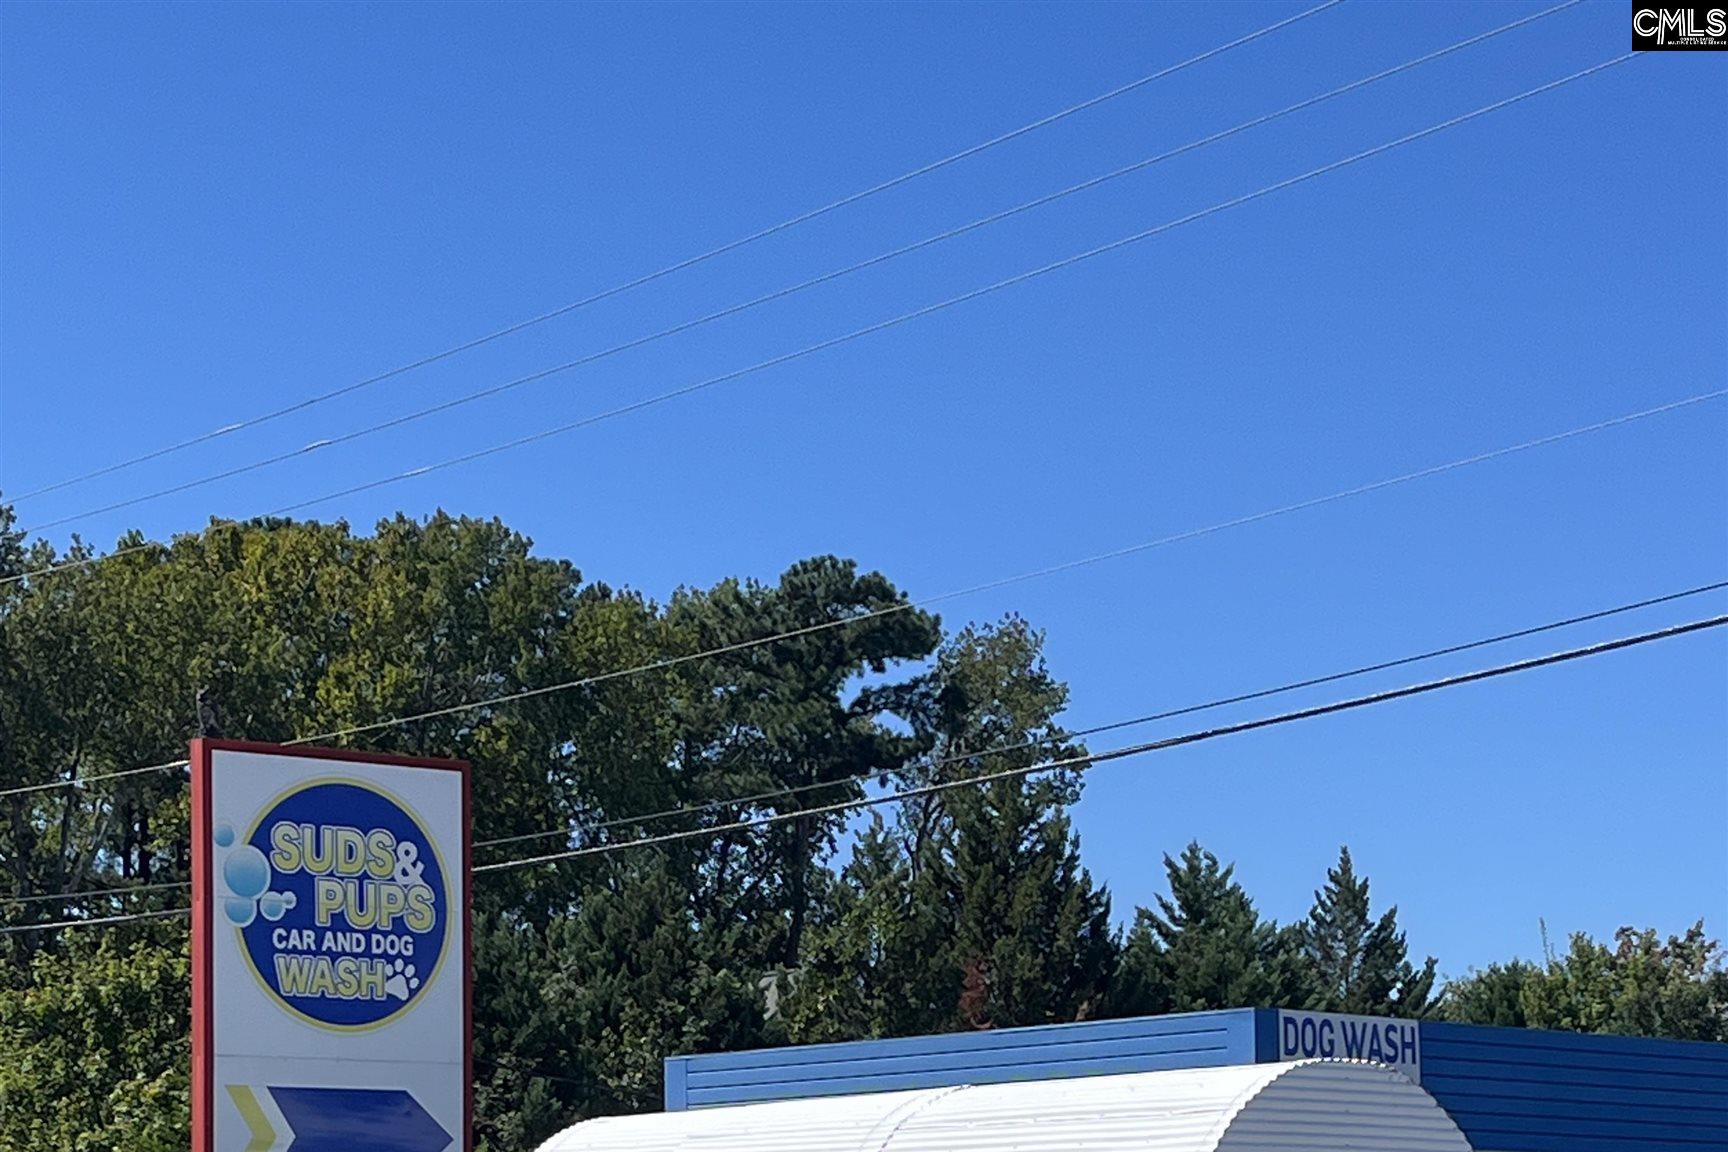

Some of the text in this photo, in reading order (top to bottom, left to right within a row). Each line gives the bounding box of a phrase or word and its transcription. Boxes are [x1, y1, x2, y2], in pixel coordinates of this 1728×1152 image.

[315, 876, 436, 934] PUPS
[272, 928, 414, 956] CAR AND DOG
[273, 953, 386, 1000] WASH
[1283, 1016, 1417, 1065] DOG WASH
